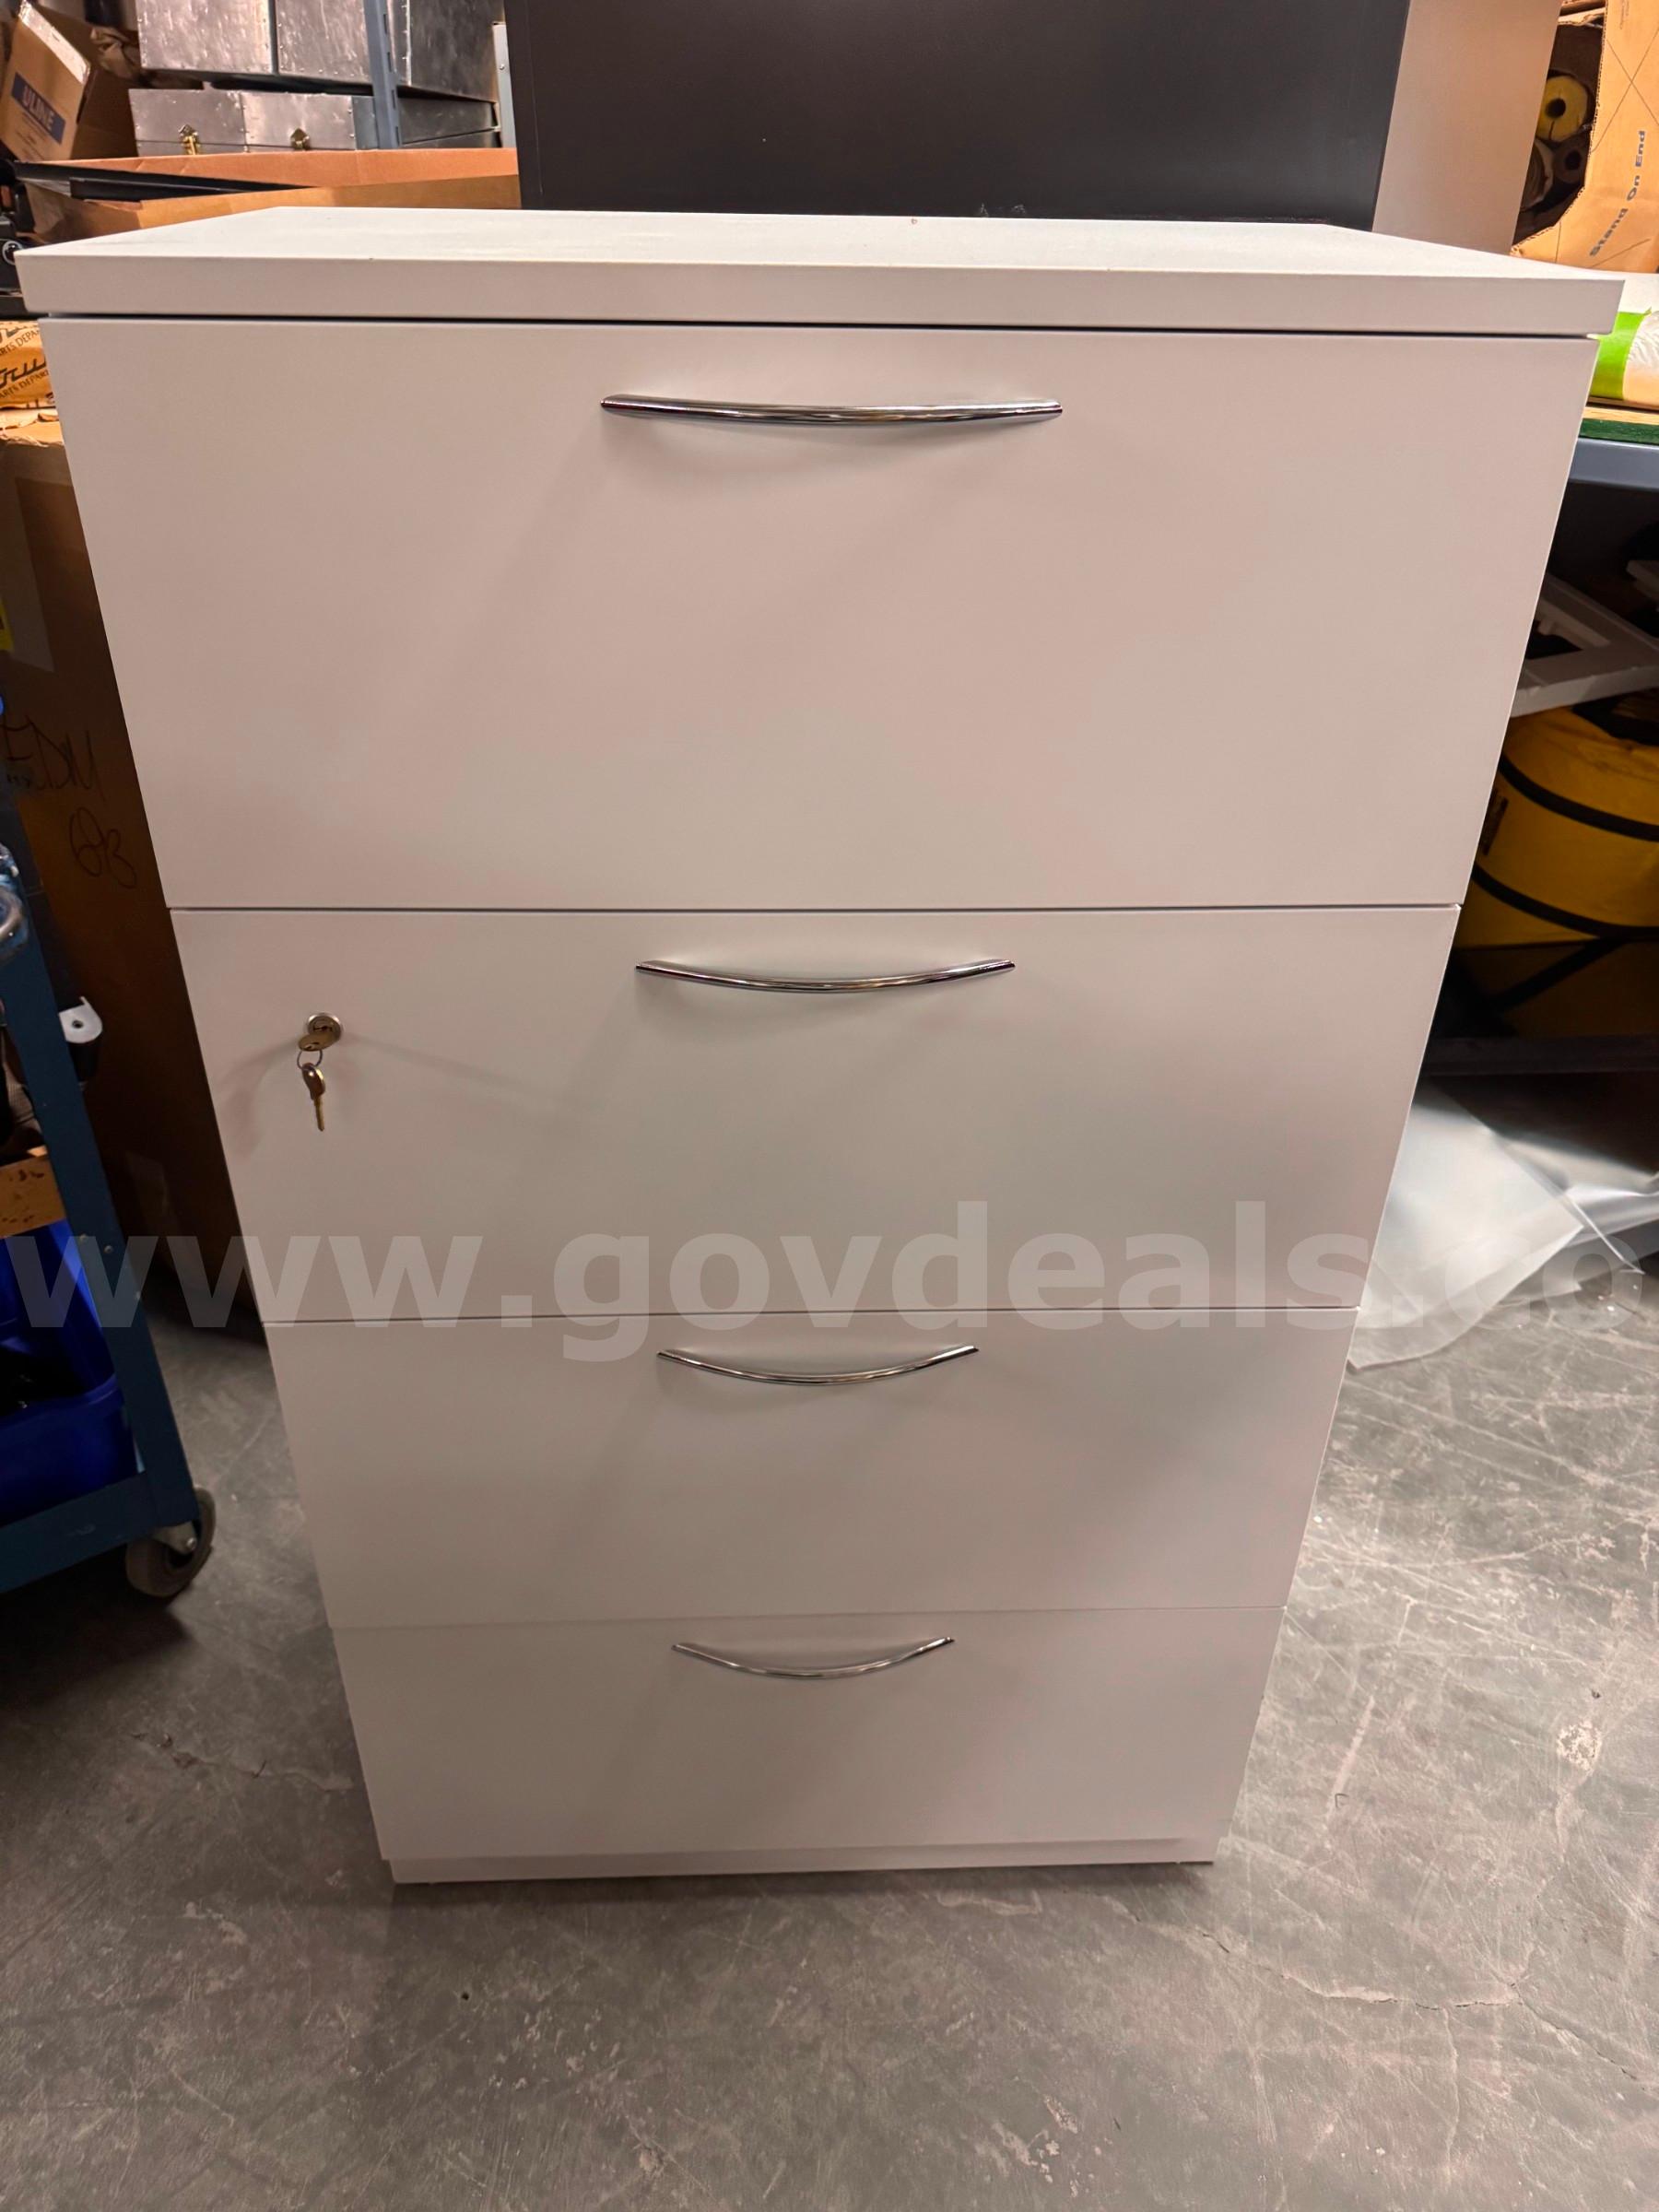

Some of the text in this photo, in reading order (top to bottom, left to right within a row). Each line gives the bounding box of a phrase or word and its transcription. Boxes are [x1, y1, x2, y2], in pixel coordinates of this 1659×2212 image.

[1589, 130, 1645, 257] Stand On End
[15, 330, 40, 347] DEPA
